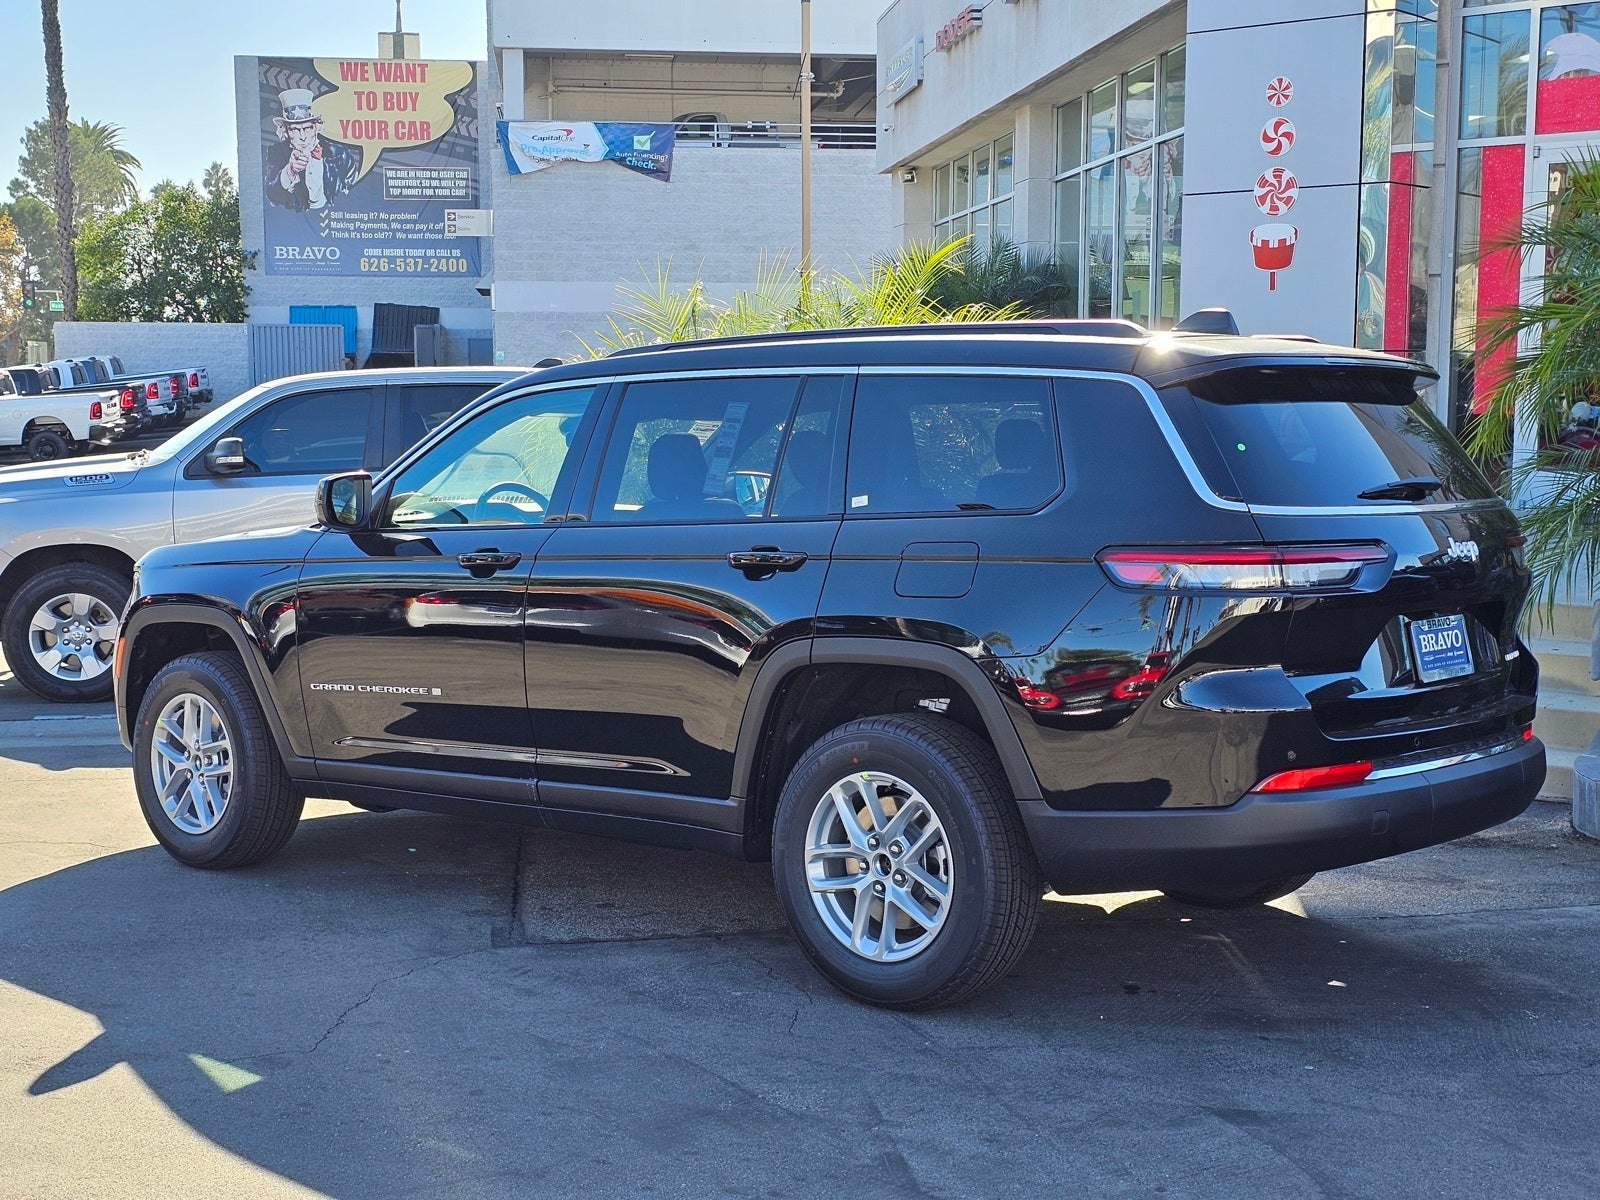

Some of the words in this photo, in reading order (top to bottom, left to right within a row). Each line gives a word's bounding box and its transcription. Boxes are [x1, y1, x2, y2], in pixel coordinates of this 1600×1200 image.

[339, 61, 369, 82] WE
[373, 62, 429, 83] WANT
[354, 91, 378, 111] TO
[383, 91, 420, 112] BUY
[339, 119, 389, 140] YOUR
[394, 120, 432, 140] CAR
[625, 157, 657, 170] Check.
[386, 170, 396, 178] WE
[396, 170, 408, 178] ARE
[416, 170, 431, 178] NEED
[389, 188, 401, 196] TOP
[401, 188, 422, 196] MONEY
[422, 188, 434, 196] FOR
[435, 188, 451, 196] YOUR
[330, 211, 344, 219] Still
[344, 211, 368, 221] leasing
[369, 211, 378, 220] it?
[379, 212, 388, 220] No
[389, 212, 420, 222] problem!
[330, 221, 355, 231] Making
[355, 221, 390, 231] Payments,
[390, 222, 402, 230] We
[415, 223, 428, 231] pay
[428, 222, 435, 230] it
[435, 222, 445, 230] off
[330, 231, 350, 239] Think
[350, 231, 361, 239] it's
[373, 231, 393, 240] old??
[395, 232, 407, 240] We
[408, 232, 424, 240] want
[424, 232, 443, 240] those
[273, 246, 341, 260] BRAVO
[363, 248, 382, 257] COME
[383, 248, 405, 257] INSIDE
[405, 248, 426, 257] TODAY
[426, 249, 436, 257] OR
[436, 249, 451, 257] CALL
[451, 249, 461, 257] US
[360, 257, 468, 273] 626-537-2400
[1447, 537, 1480, 562] Jeep
[1426, 617, 1451, 629] BRAVO
[1418, 629, 1462, 653] BRAVO
[310, 683, 355, 691] GRAND
[357, 685, 429, 695] CHEROKEE
